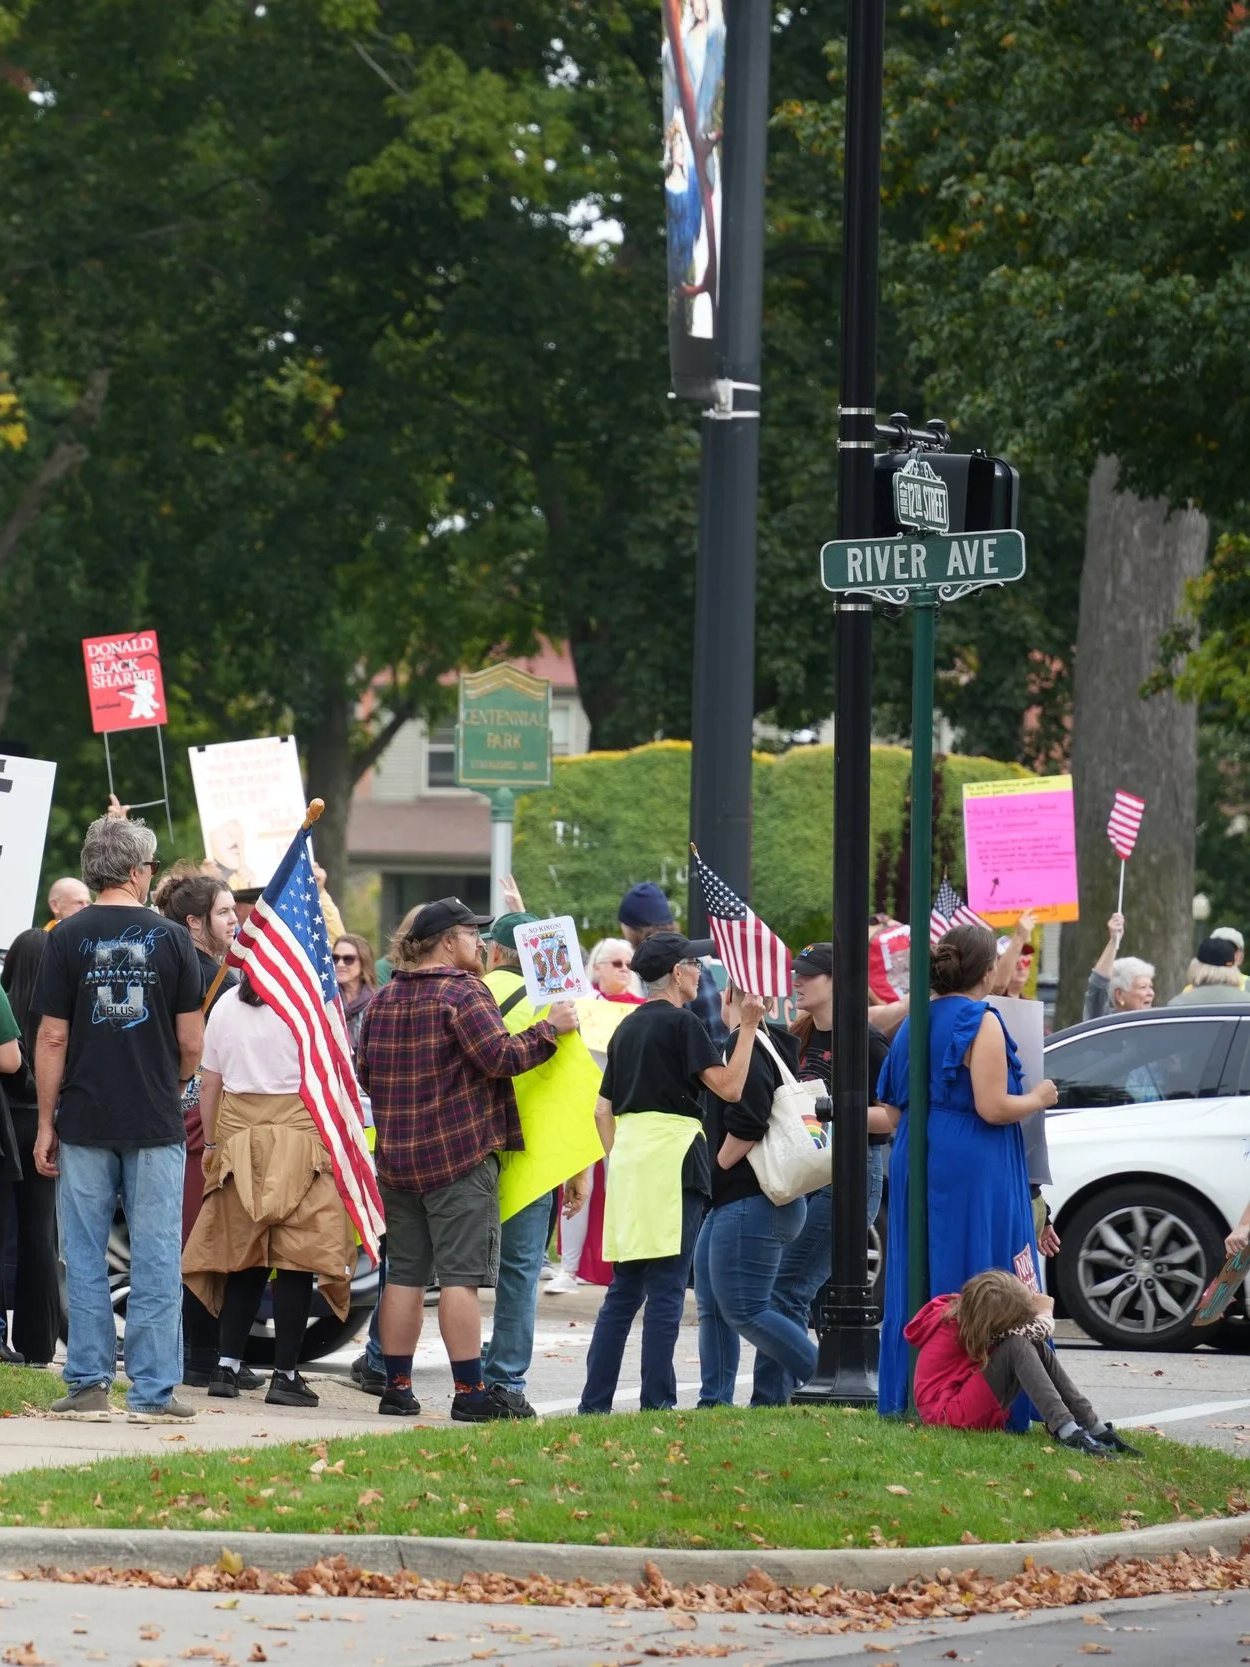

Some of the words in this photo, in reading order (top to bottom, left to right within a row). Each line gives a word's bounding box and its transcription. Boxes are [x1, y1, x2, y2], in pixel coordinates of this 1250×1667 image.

[923, 485, 947, 524] STREET
[847, 543, 927, 583] RIVER
[946, 538, 999, 576] AVE
[87, 637, 153, 658] DONALD
[91, 658, 140, 676] BLACK
[92, 669, 156, 689] SHARPIE
[463, 708, 548, 728] CENTENNIAL
[486, 732, 523, 749] PARK
[85, 969, 158, 985] ANALYSIS
[106, 1006, 134, 1016] PLUS
